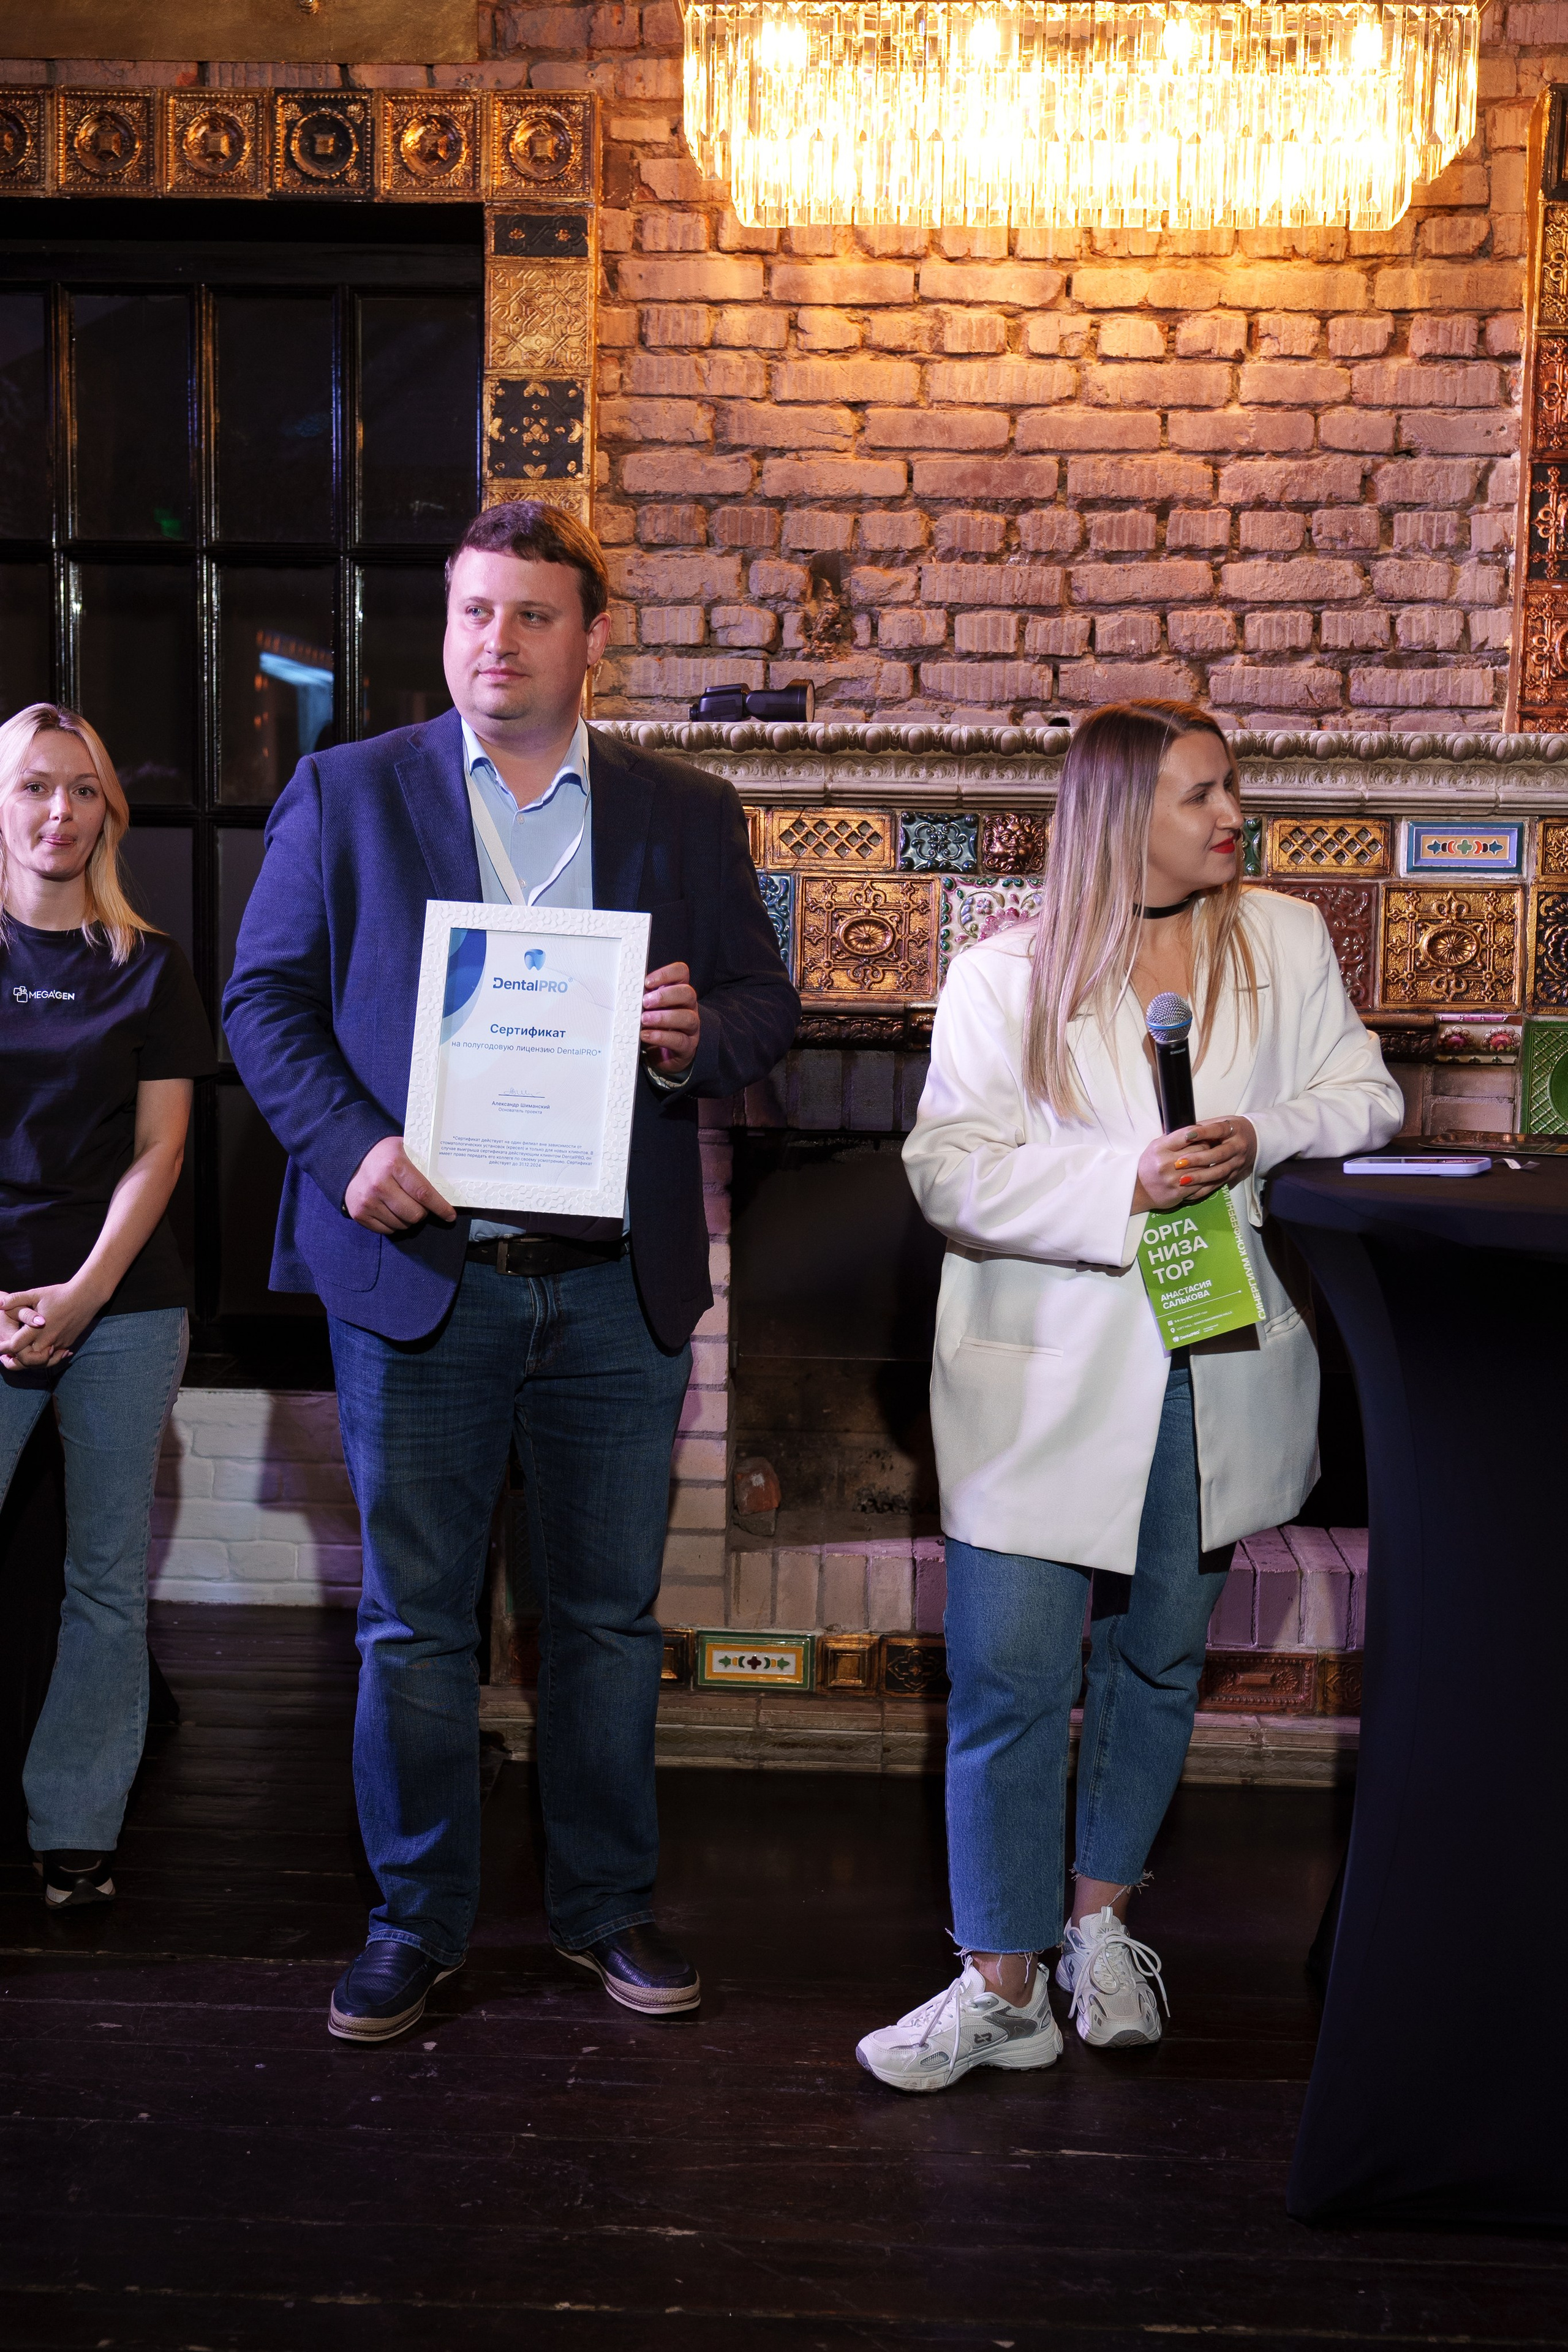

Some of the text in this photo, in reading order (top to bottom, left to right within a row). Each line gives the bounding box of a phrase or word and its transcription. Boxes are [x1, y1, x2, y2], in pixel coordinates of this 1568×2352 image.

[490, 1023, 566, 1038] Сертификат
[463, 1042, 514, 1051] полугодовую
[1143, 1218, 1199, 1245] ОРГА
[1148, 1235, 1208, 1265] НИЗА
[1153, 1259, 1194, 1284] ТОР
[1161, 1280, 1213, 1302] АНАСТАСИЯ
[1242, 1257, 1266, 1319] СИНЕРГИУМ
[1163, 1290, 1210, 1310] САЛЬКОВА
